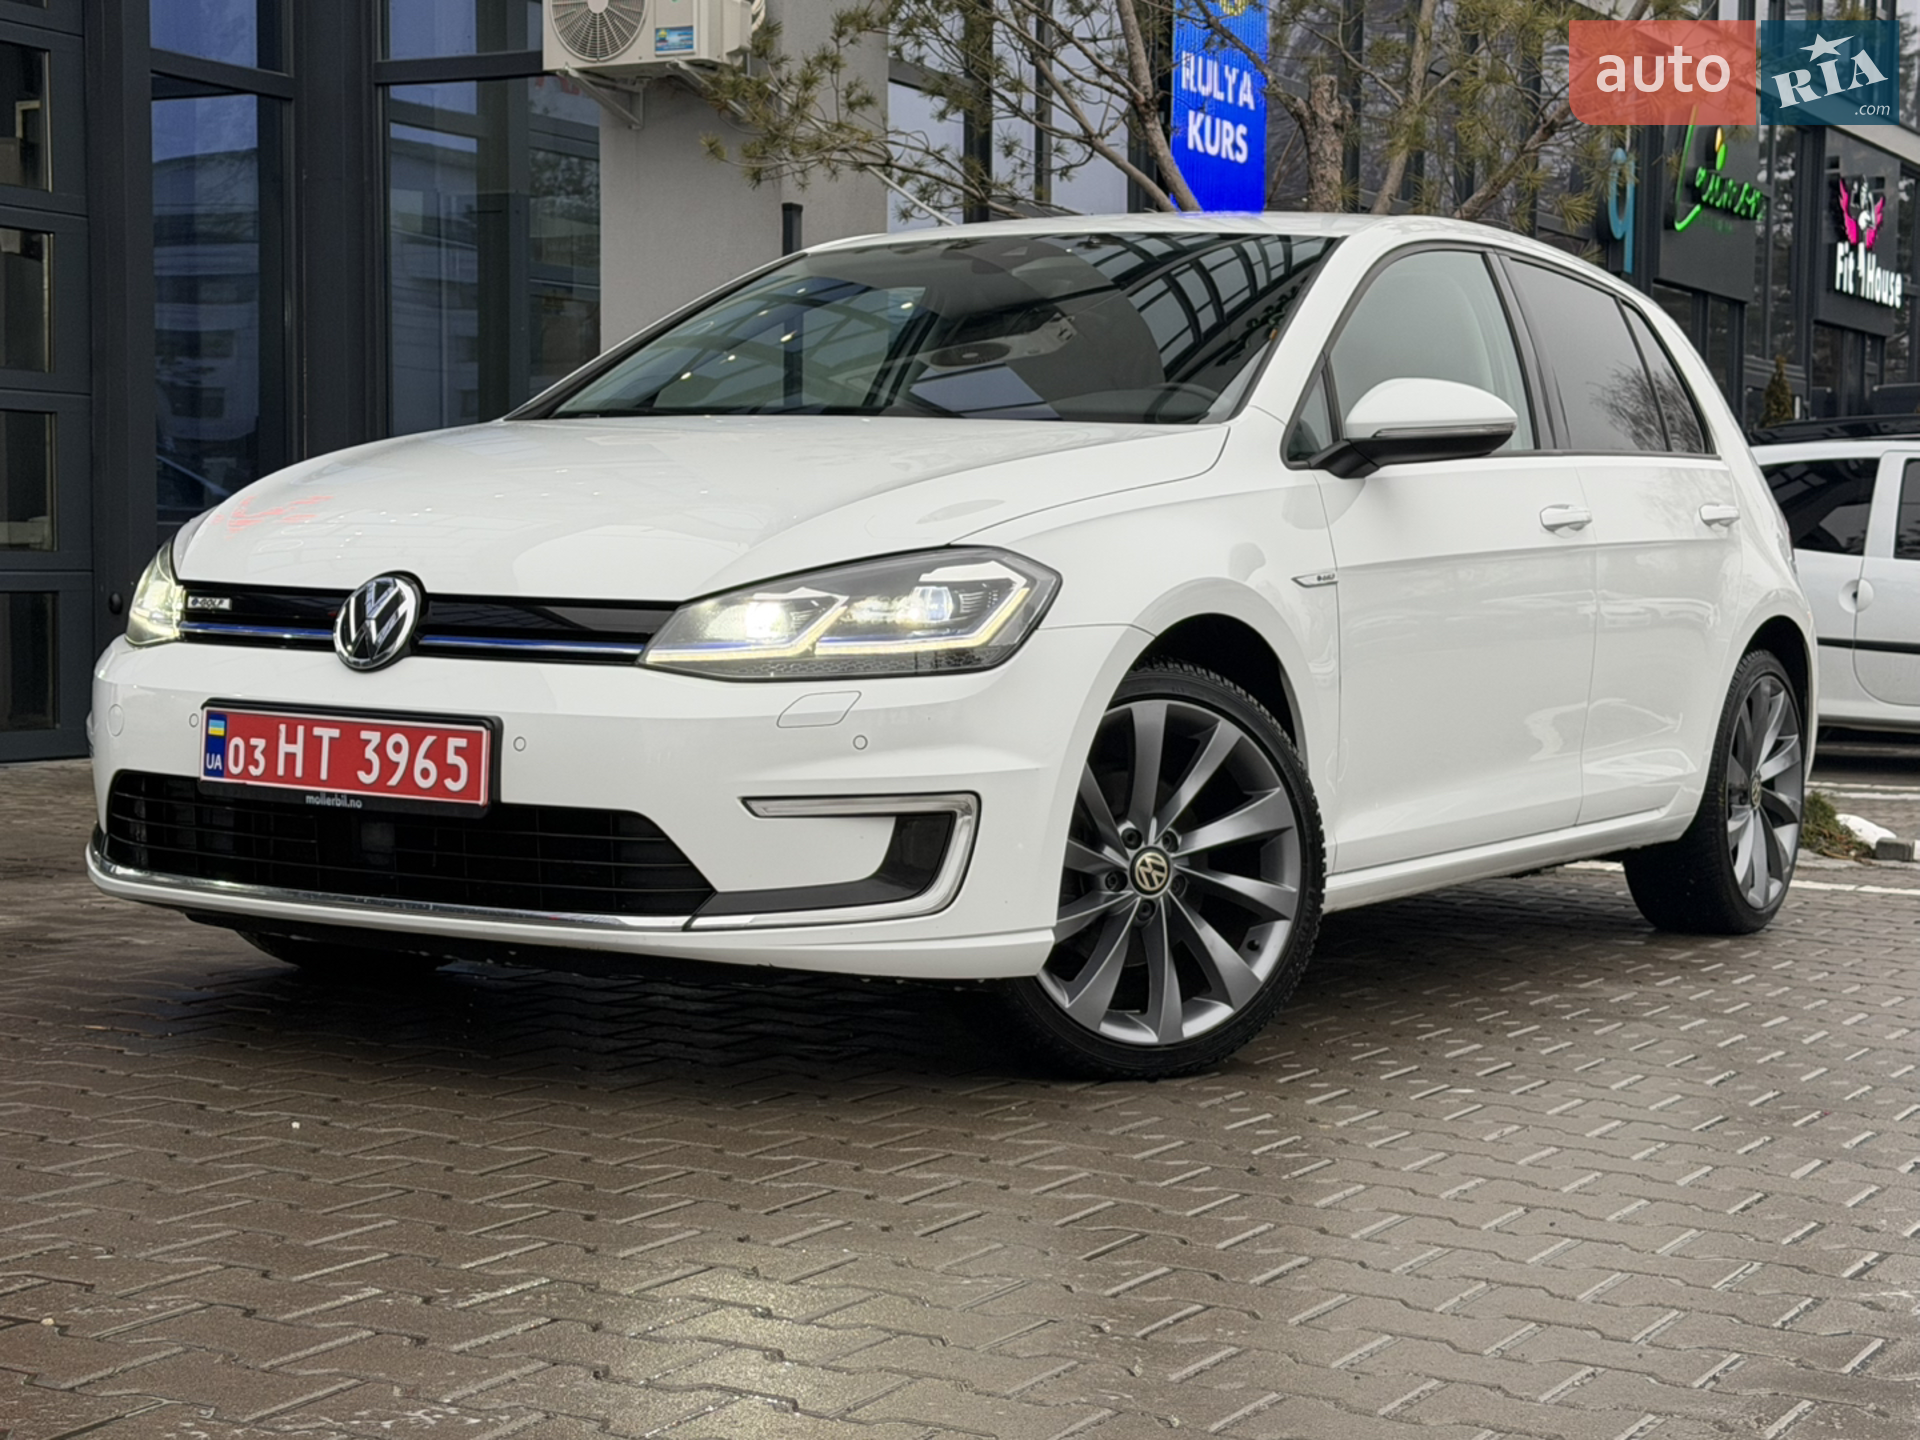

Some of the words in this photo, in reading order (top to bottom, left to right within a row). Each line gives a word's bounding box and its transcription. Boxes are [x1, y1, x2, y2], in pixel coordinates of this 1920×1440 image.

[1187, 109, 1249, 164] KURS
[1835, 241, 1855, 295] Fit
[1865, 252, 1902, 309] House
[205, 752, 223, 771] UA
[227, 736, 267, 777] 03
[277, 723, 341, 781] HT
[356, 729, 469, 793] 3965
